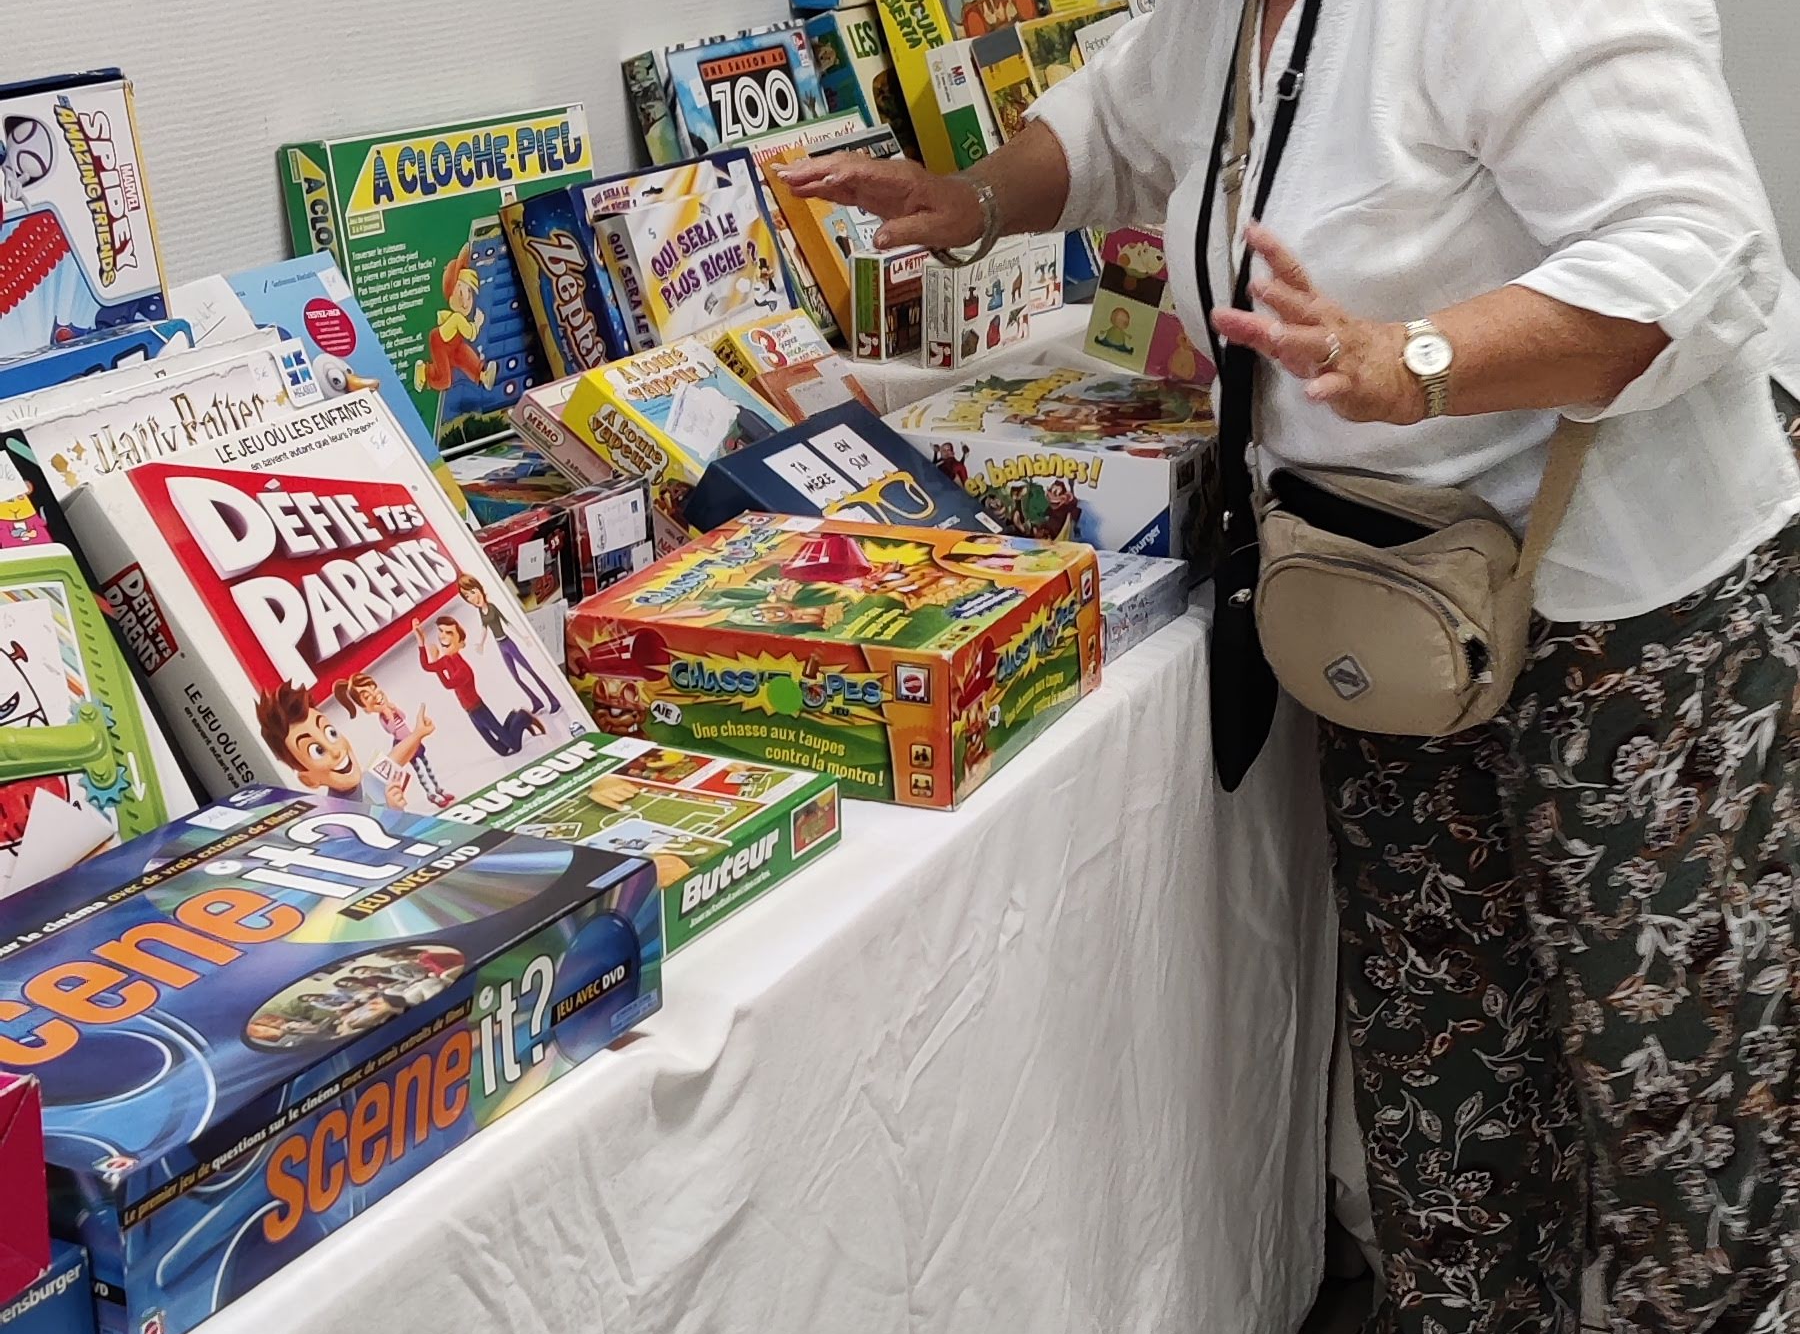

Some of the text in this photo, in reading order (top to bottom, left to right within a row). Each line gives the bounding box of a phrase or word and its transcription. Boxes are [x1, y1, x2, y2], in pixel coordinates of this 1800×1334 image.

[702, 51, 786, 79] UNE SAISON AU
[846, 21, 880, 60] LES
[709, 67, 800, 145] ZOO
[950, 64, 967, 86] MB
[54, 104, 117, 289] AMAZING FRIENDS
[78, 110, 139, 273] SPIDEY
[119, 162, 142, 213] MARVEL
[372, 149, 396, 206] À
[309, 199, 335, 253] CLO
[651, 212, 740, 279] QUI SERA LE
[607, 231, 630, 263] QUI
[620, 265, 643, 312] SERA
[634, 315, 650, 335] LE
[660, 240, 759, 313] PLUS RICHE ?
[91, 391, 266, 475] Harry Potter
[215, 398, 373, 465] LE JEU OÙ LES ENFANTS
[526, 412, 560, 444] MEMO
[592, 416, 654, 474] vapeur
[619, 420, 664, 465] toute
[833, 438, 854, 454] EN
[165, 475, 425, 577] DÉFIE TES
[1127, 523, 1163, 556] burger
[103, 584, 161, 671] PARENTS
[117, 568, 174, 658] DÉFIE TES
[229, 537, 459, 692] PARENTS
[184, 682, 203, 705] LE
[196, 704, 222, 733] JEU
[216, 731, 238, 755] OÙ
[230, 753, 255, 784] LES
[651, 701, 673, 721] AÏE
[692, 719, 847, 757] Une chasse aux taupes
[829, 705, 850, 717] JEU
[434, 739, 600, 825] Buteur
[764, 745, 811, 766] contre
[811, 752, 825, 771] la
[827, 762, 876, 786] montre
[17, 930, 44, 943] le
[42, 900, 109, 933] cinéma
[107, 883, 144, 902] avec
[142, 873, 164, 886] de
[161, 856, 199, 876] vrais
[197, 832, 250, 859] extraits
[248, 823, 268, 836] de
[263, 808, 301, 827] films
[204, 810, 440, 901] it?
[350, 845, 482, 915] JEU AVEC DVD
[681, 827, 780, 915] Buteur
[556, 964, 627, 1022] JEU AVEC DVD
[211, 1128, 267, 1171] questions
[267, 1115, 288, 1135] sur
[288, 1106, 300, 1123] le
[300, 1081, 341, 1116] cinéma
[262, 954, 556, 1244] scene it?
